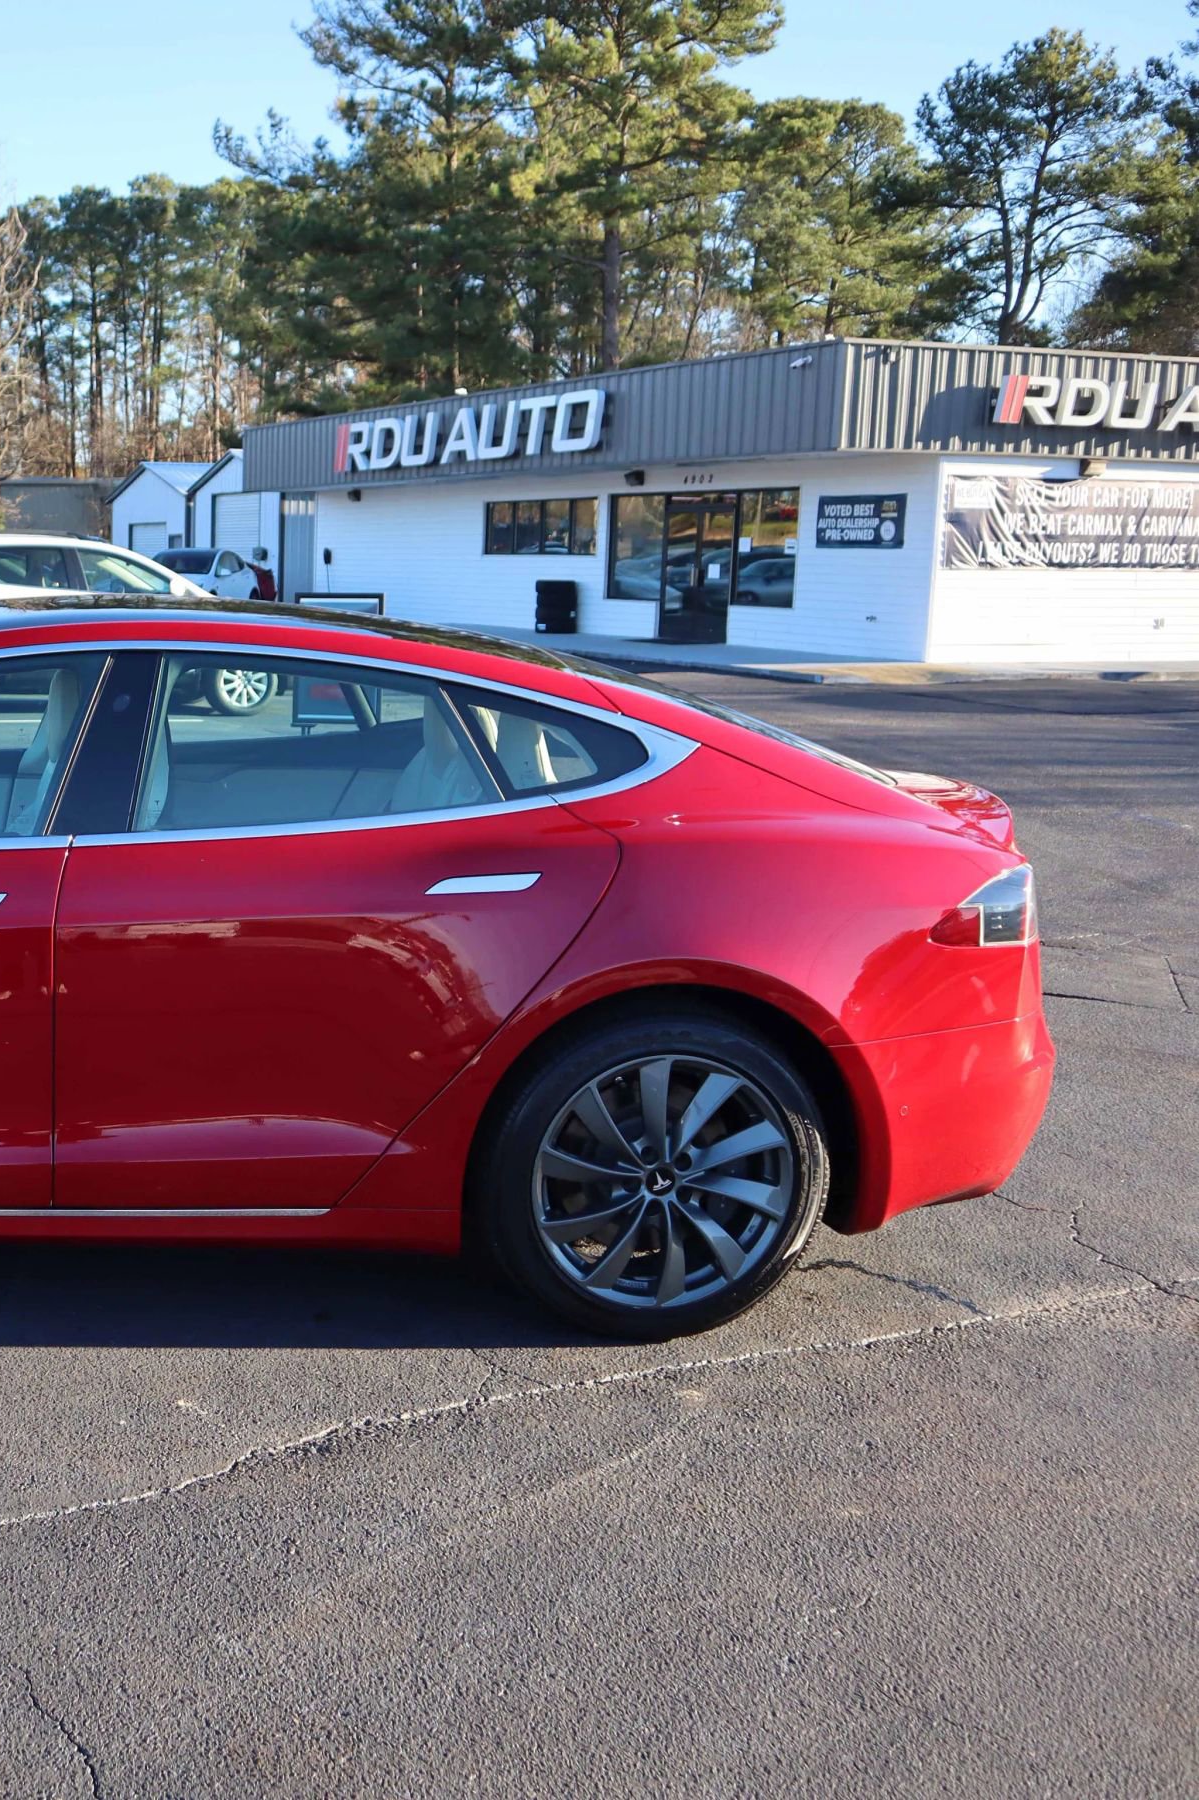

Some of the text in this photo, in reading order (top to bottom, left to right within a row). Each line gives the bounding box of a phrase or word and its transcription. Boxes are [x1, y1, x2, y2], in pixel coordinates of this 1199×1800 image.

[1023, 376, 1160, 429] RDU
[346, 389, 606, 471] RDU AUTO
[1054, 486, 1089, 508] YOUR
[1093, 487, 1119, 508] CAR
[1123, 487, 1149, 508] FOR
[1152, 487, 1194, 509] MORE!
[824, 504, 852, 517] VOTED
[853, 503, 875, 517] BEST
[818, 517, 880, 529] AUTO DEALERSHIP
[1068, 514, 1124, 536] CARMAX
[825, 529, 875, 541] PRE-OWNED
[1099, 542, 1120, 564] WE
[1122, 542, 1141, 564] DO
[1145, 543, 1188, 564] THOSE
